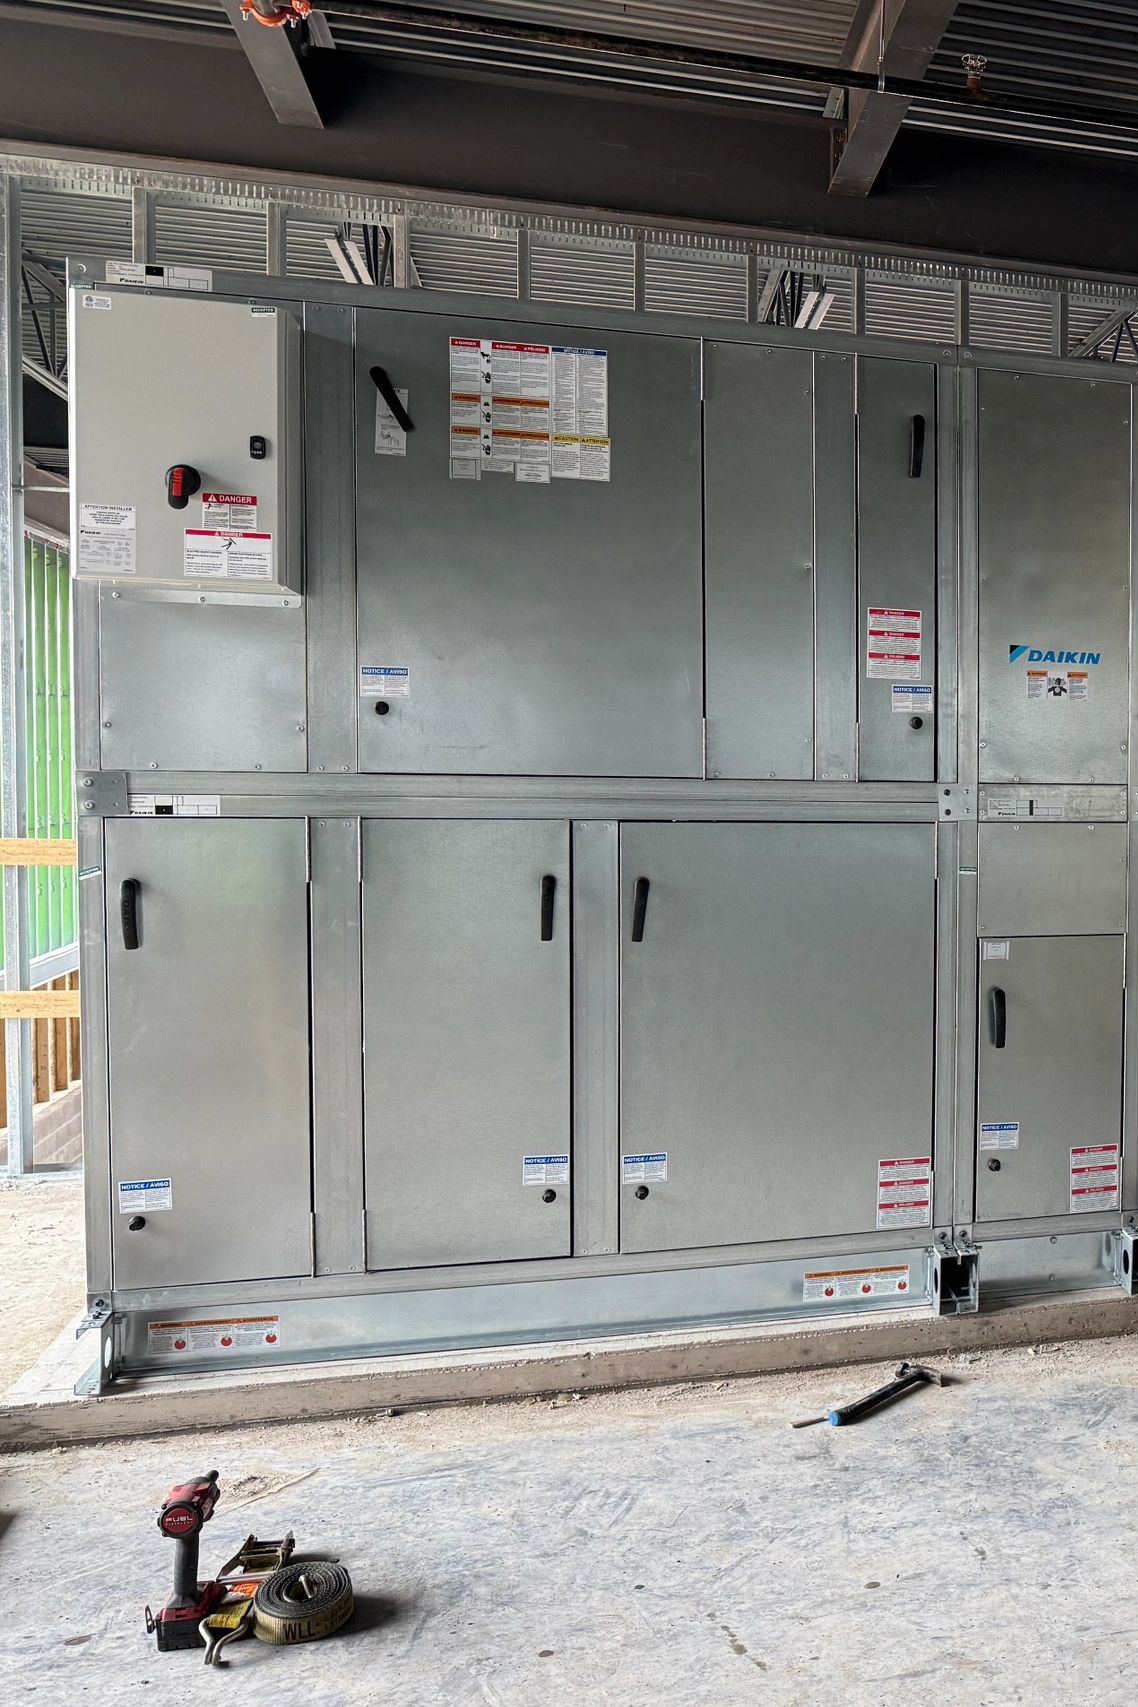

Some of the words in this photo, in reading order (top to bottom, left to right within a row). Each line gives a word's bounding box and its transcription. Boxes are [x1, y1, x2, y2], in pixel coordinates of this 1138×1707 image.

[219, 495, 252, 504] DANGER
[1028, 649, 1101, 665] DAIKIN
[165, 1515, 193, 1523] FUEL
